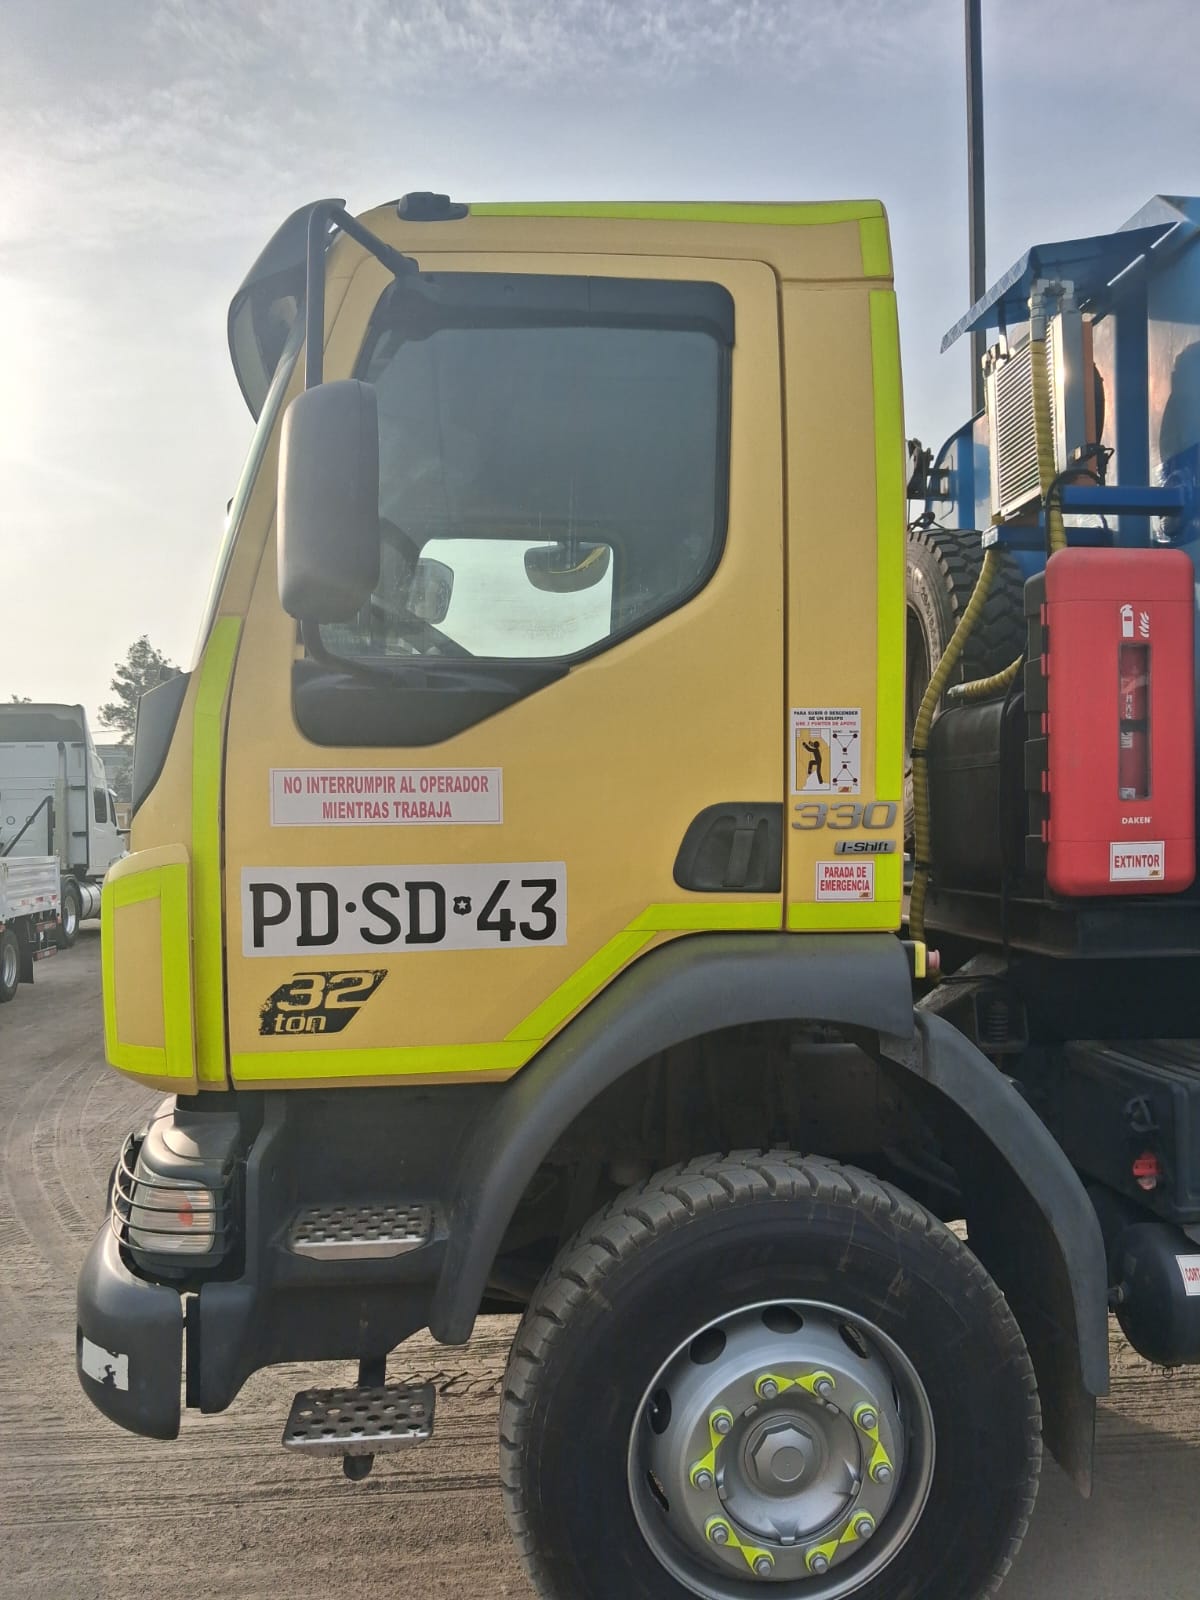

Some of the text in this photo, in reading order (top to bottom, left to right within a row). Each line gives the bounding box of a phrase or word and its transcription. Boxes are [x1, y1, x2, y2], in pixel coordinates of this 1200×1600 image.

[283, 775, 489, 794] NO INTERRUMPIR AL OPERADOR
[322, 800, 452, 819] MIENTRAS TRABAJA
[792, 801, 898, 830] 330
[1121, 816, 1151, 824] DAKEN
[841, 841, 889, 853] I-Shift
[1114, 854, 1160, 868] EXTINTOR
[824, 866, 867, 878] PARADA DE
[820, 879, 870, 891] EMERGENCIA
[276, 972, 376, 1012] 32
[274, 1013, 327, 1032] ton
